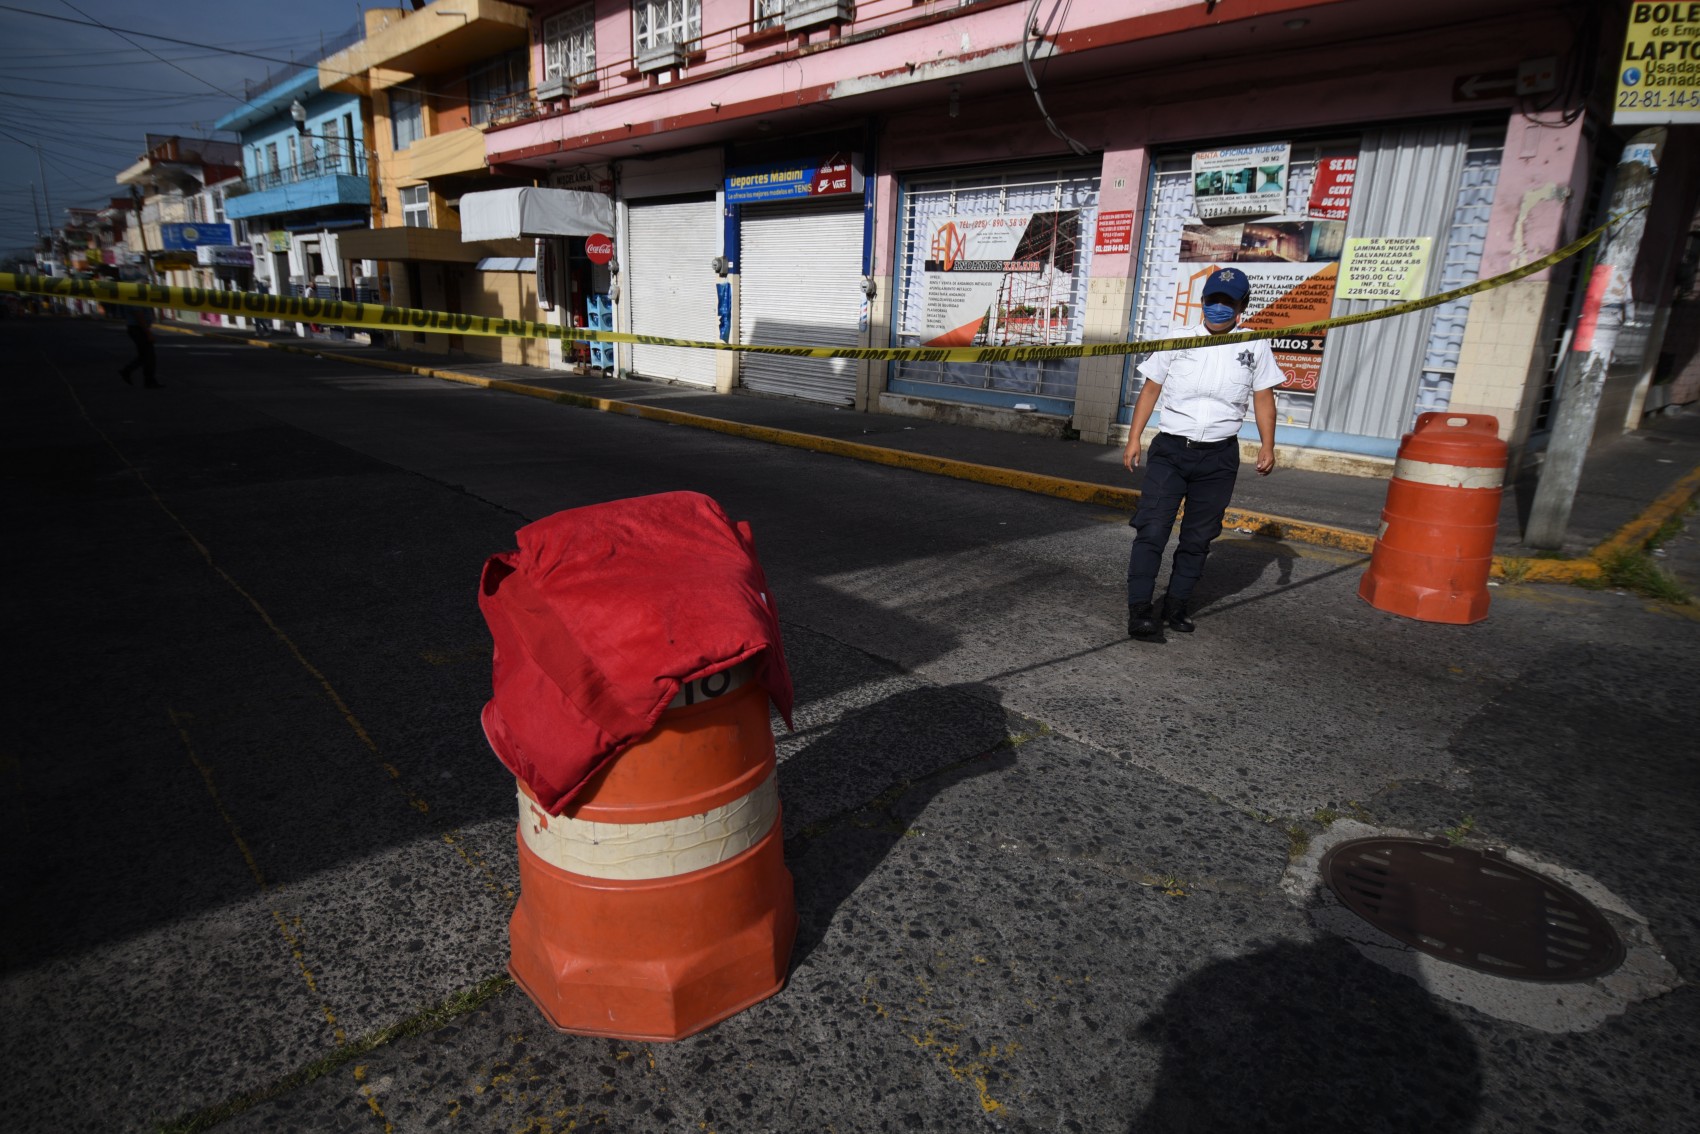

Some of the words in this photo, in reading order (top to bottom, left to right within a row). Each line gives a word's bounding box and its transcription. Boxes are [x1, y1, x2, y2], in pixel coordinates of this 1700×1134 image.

[1652, 26, 1669, 36] de
[1220, 148, 1253, 158] OFICINAS
[1254, 144, 1286, 154] NUEVAS
[1329, 158, 1344, 170] SE
[730, 173, 768, 190] Deportes
[832, 179, 846, 189] VANS
[794, 184, 812, 194] TENIS
[954, 260, 1002, 271] ANDAMIOS
[1003, 261, 1040, 272] XALAPA
